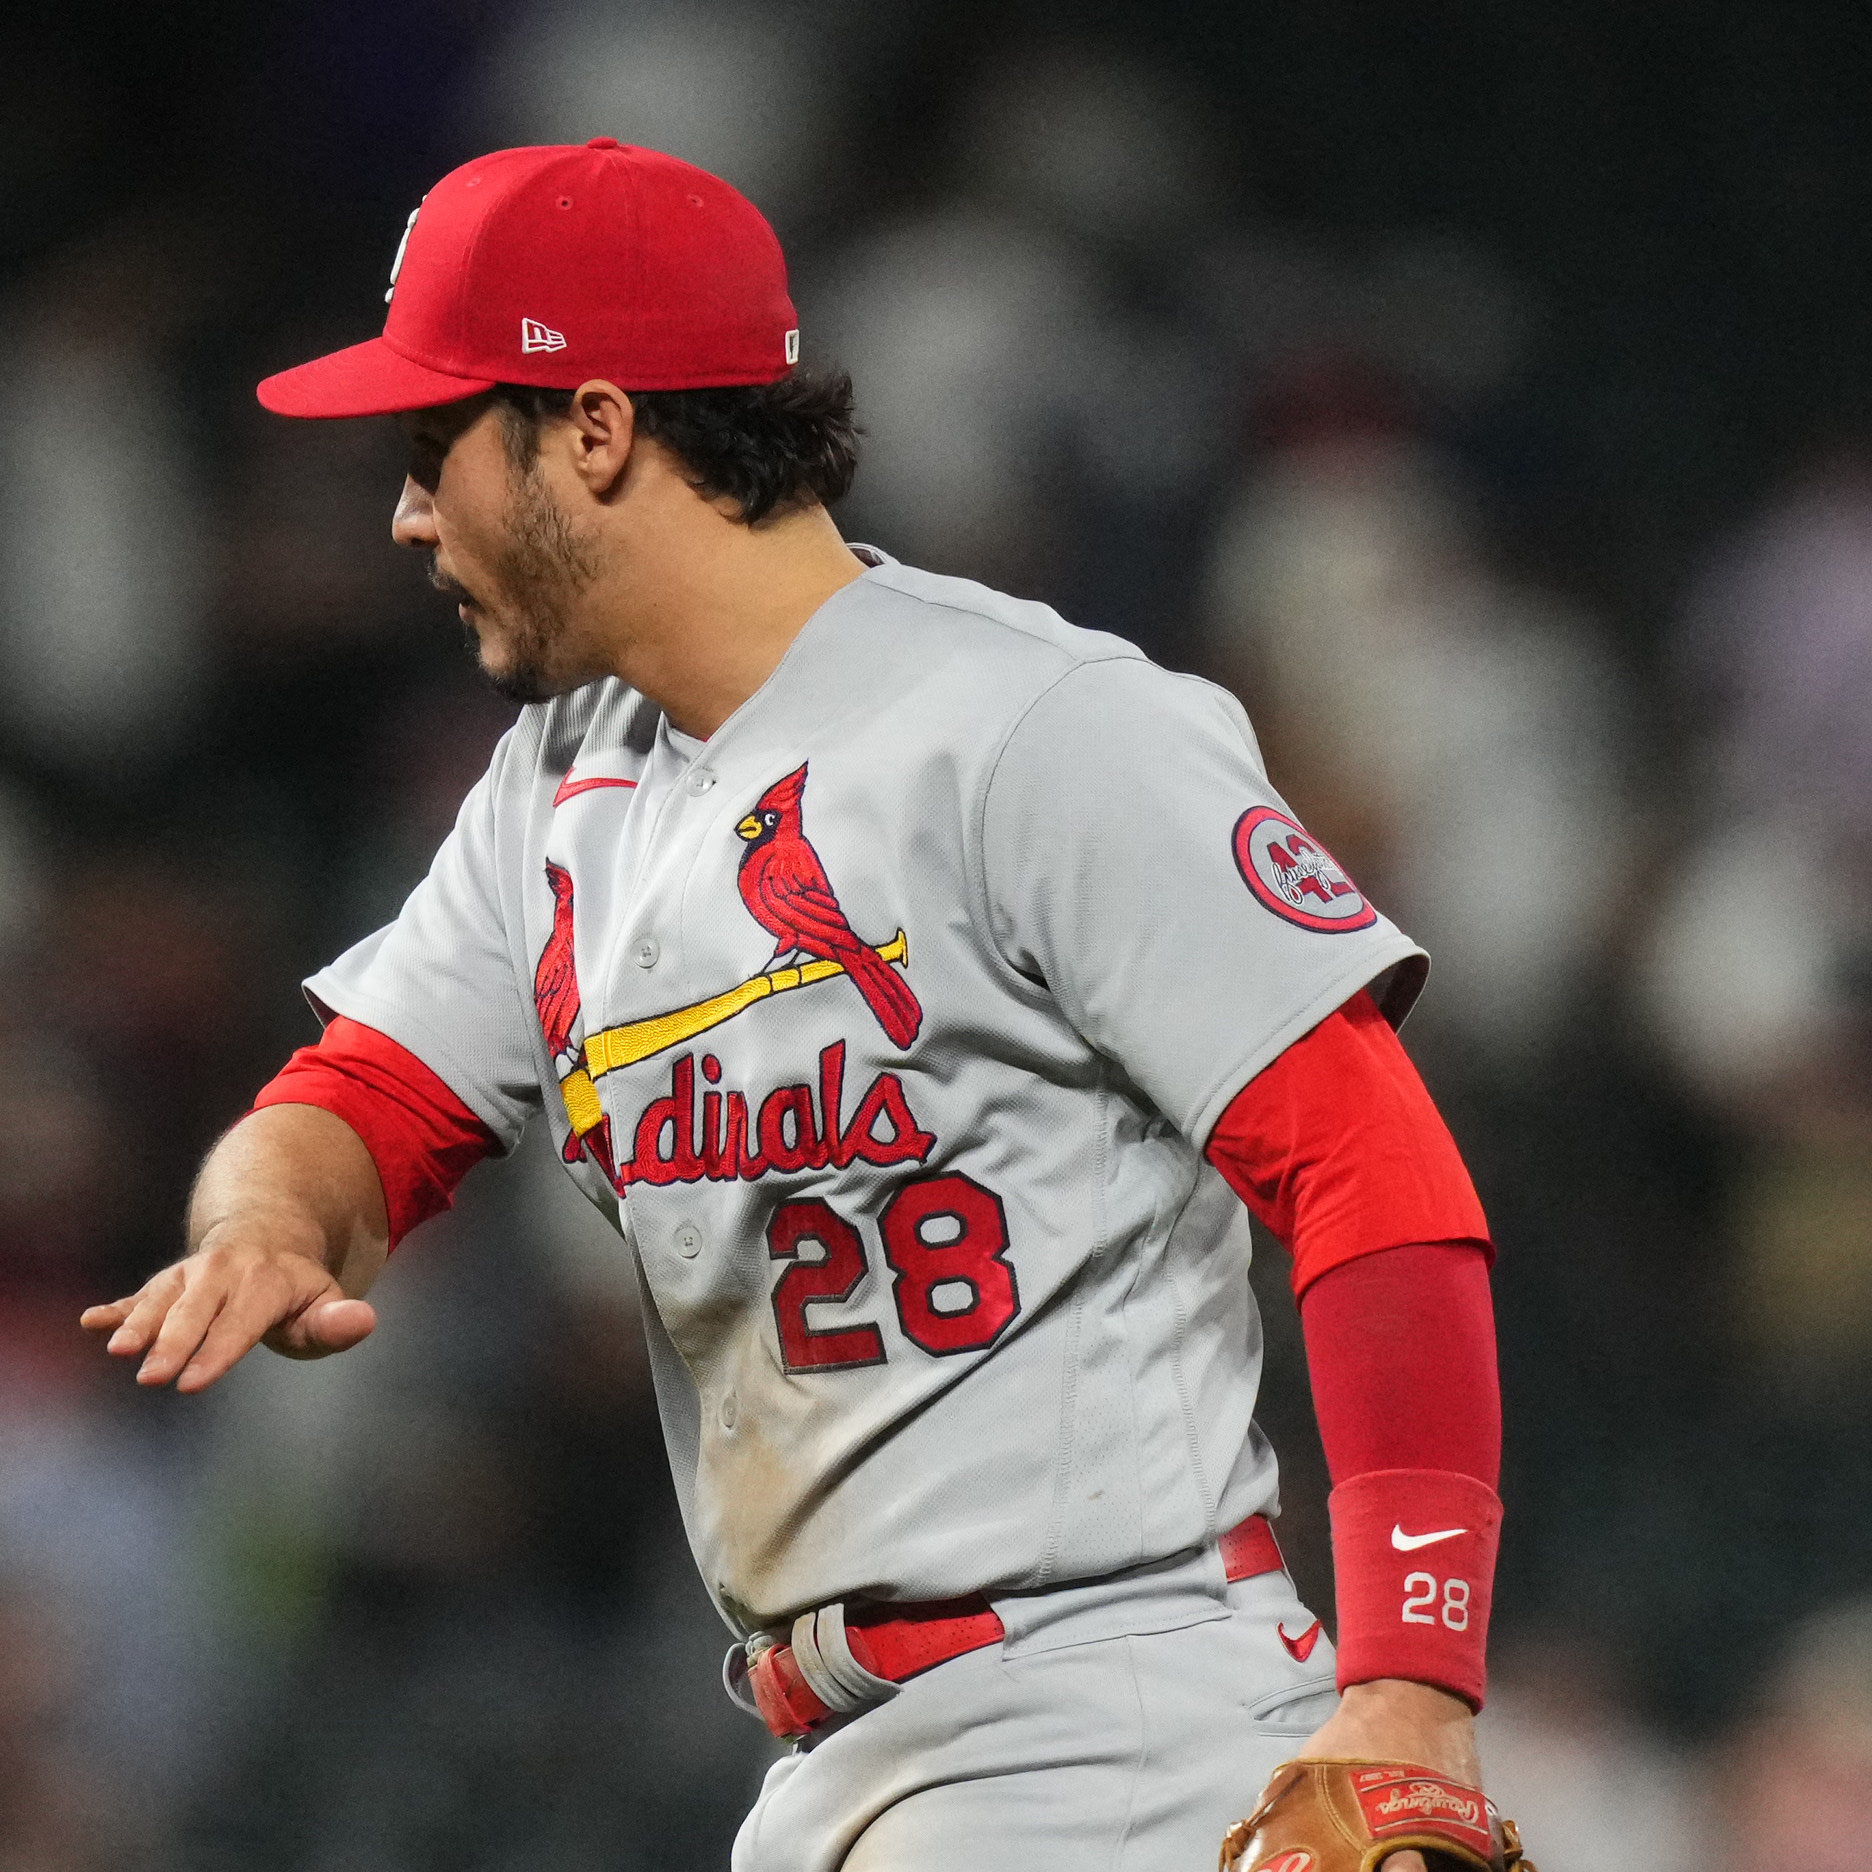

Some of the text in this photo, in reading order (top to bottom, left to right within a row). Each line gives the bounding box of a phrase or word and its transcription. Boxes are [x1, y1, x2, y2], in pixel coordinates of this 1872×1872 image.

[765, 1169, 1022, 1375] 28
[1401, 1571, 1471, 1632] 28
[1375, 1782, 1479, 1824] Rawlings
